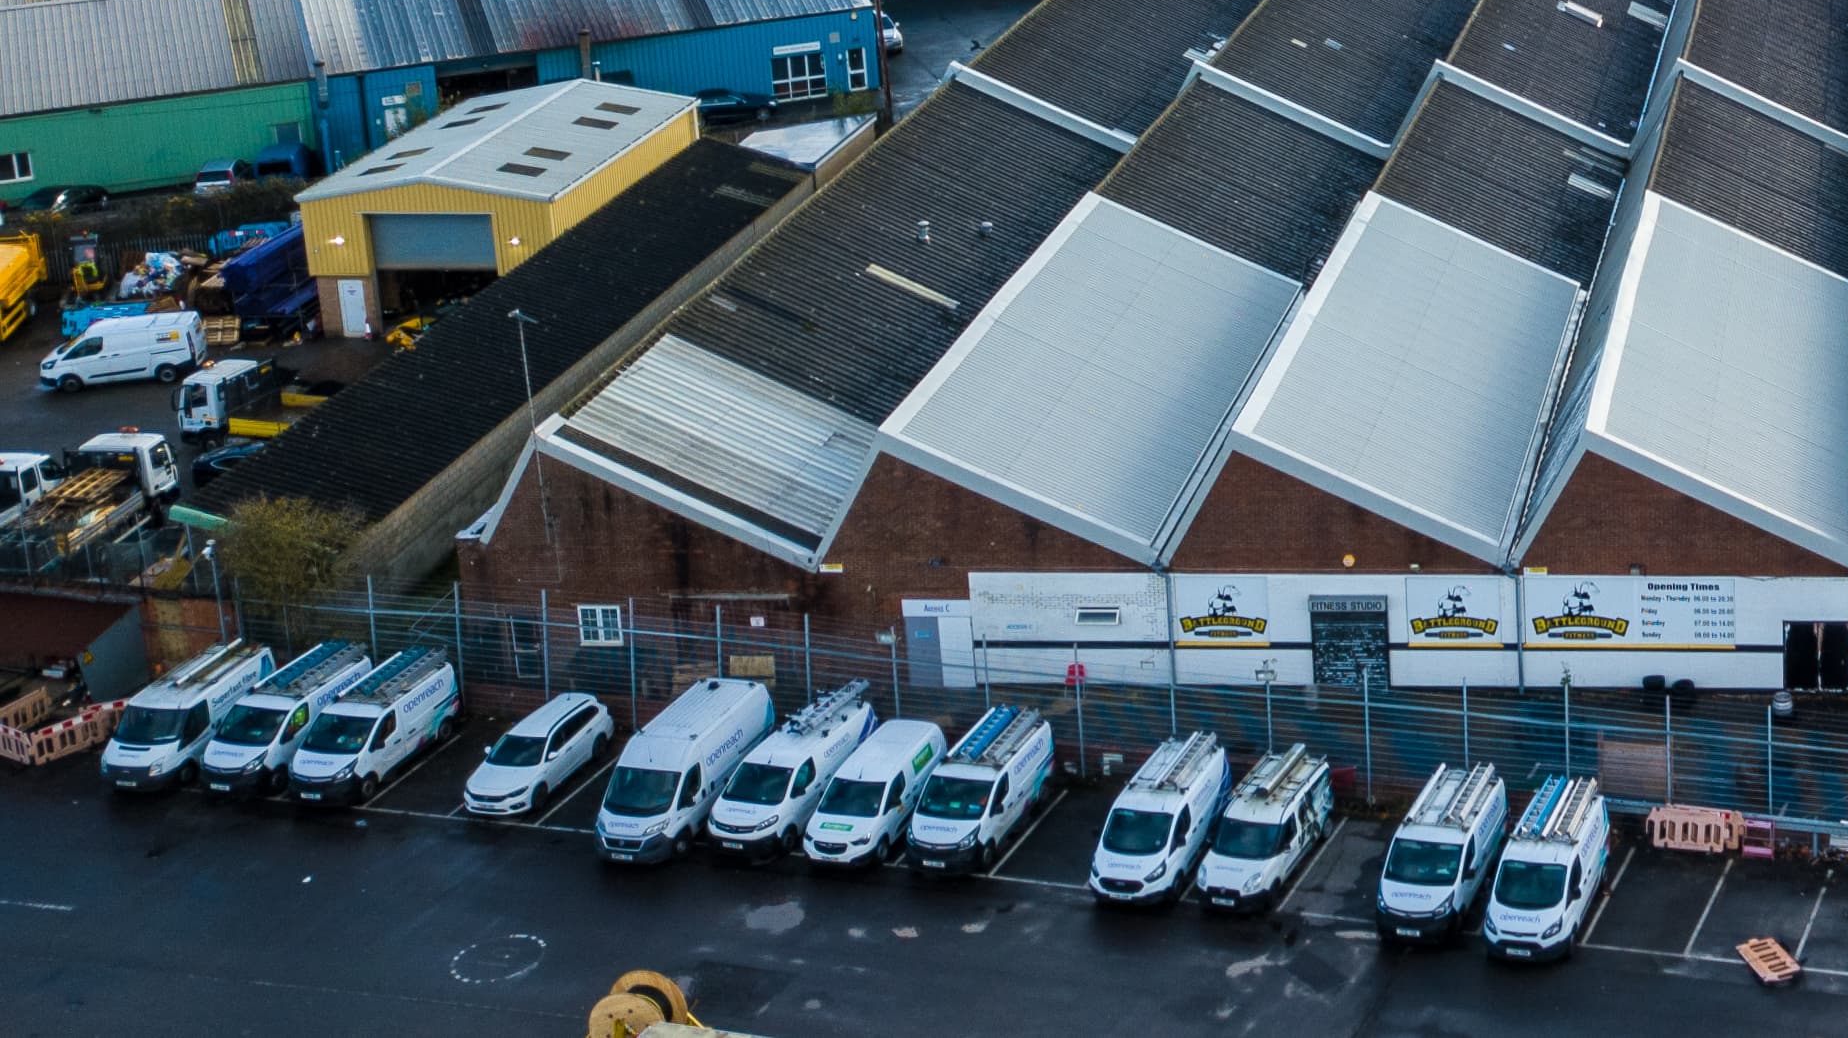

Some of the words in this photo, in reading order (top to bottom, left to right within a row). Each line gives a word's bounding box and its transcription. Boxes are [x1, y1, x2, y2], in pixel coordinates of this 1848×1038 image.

[1647, 582, 1689, 592] Opening
[1690, 582, 1720, 591] Times
[1311, 601, 1348, 611] FITNESS
[1350, 601, 1383, 611] STUDIO
[1181, 616, 1266, 632] BATTLEGROUND
[1411, 616, 1496, 633] BATTLEGROUND
[1534, 616, 1628, 635] BATTLEGROUND
[1564, 631, 1595, 640] FITNESS
[211, 679, 243, 708] Superfast
[242, 670, 258, 689] fibre
[316, 671, 362, 707] openreach
[402, 677, 445, 714] openreach
[705, 727, 744, 767] openreach
[1014, 737, 1045, 775] openreach
[919, 824, 958, 833] openreach
[1391, 890, 1432, 900] openreach
[1500, 912, 1541, 923] openreach
